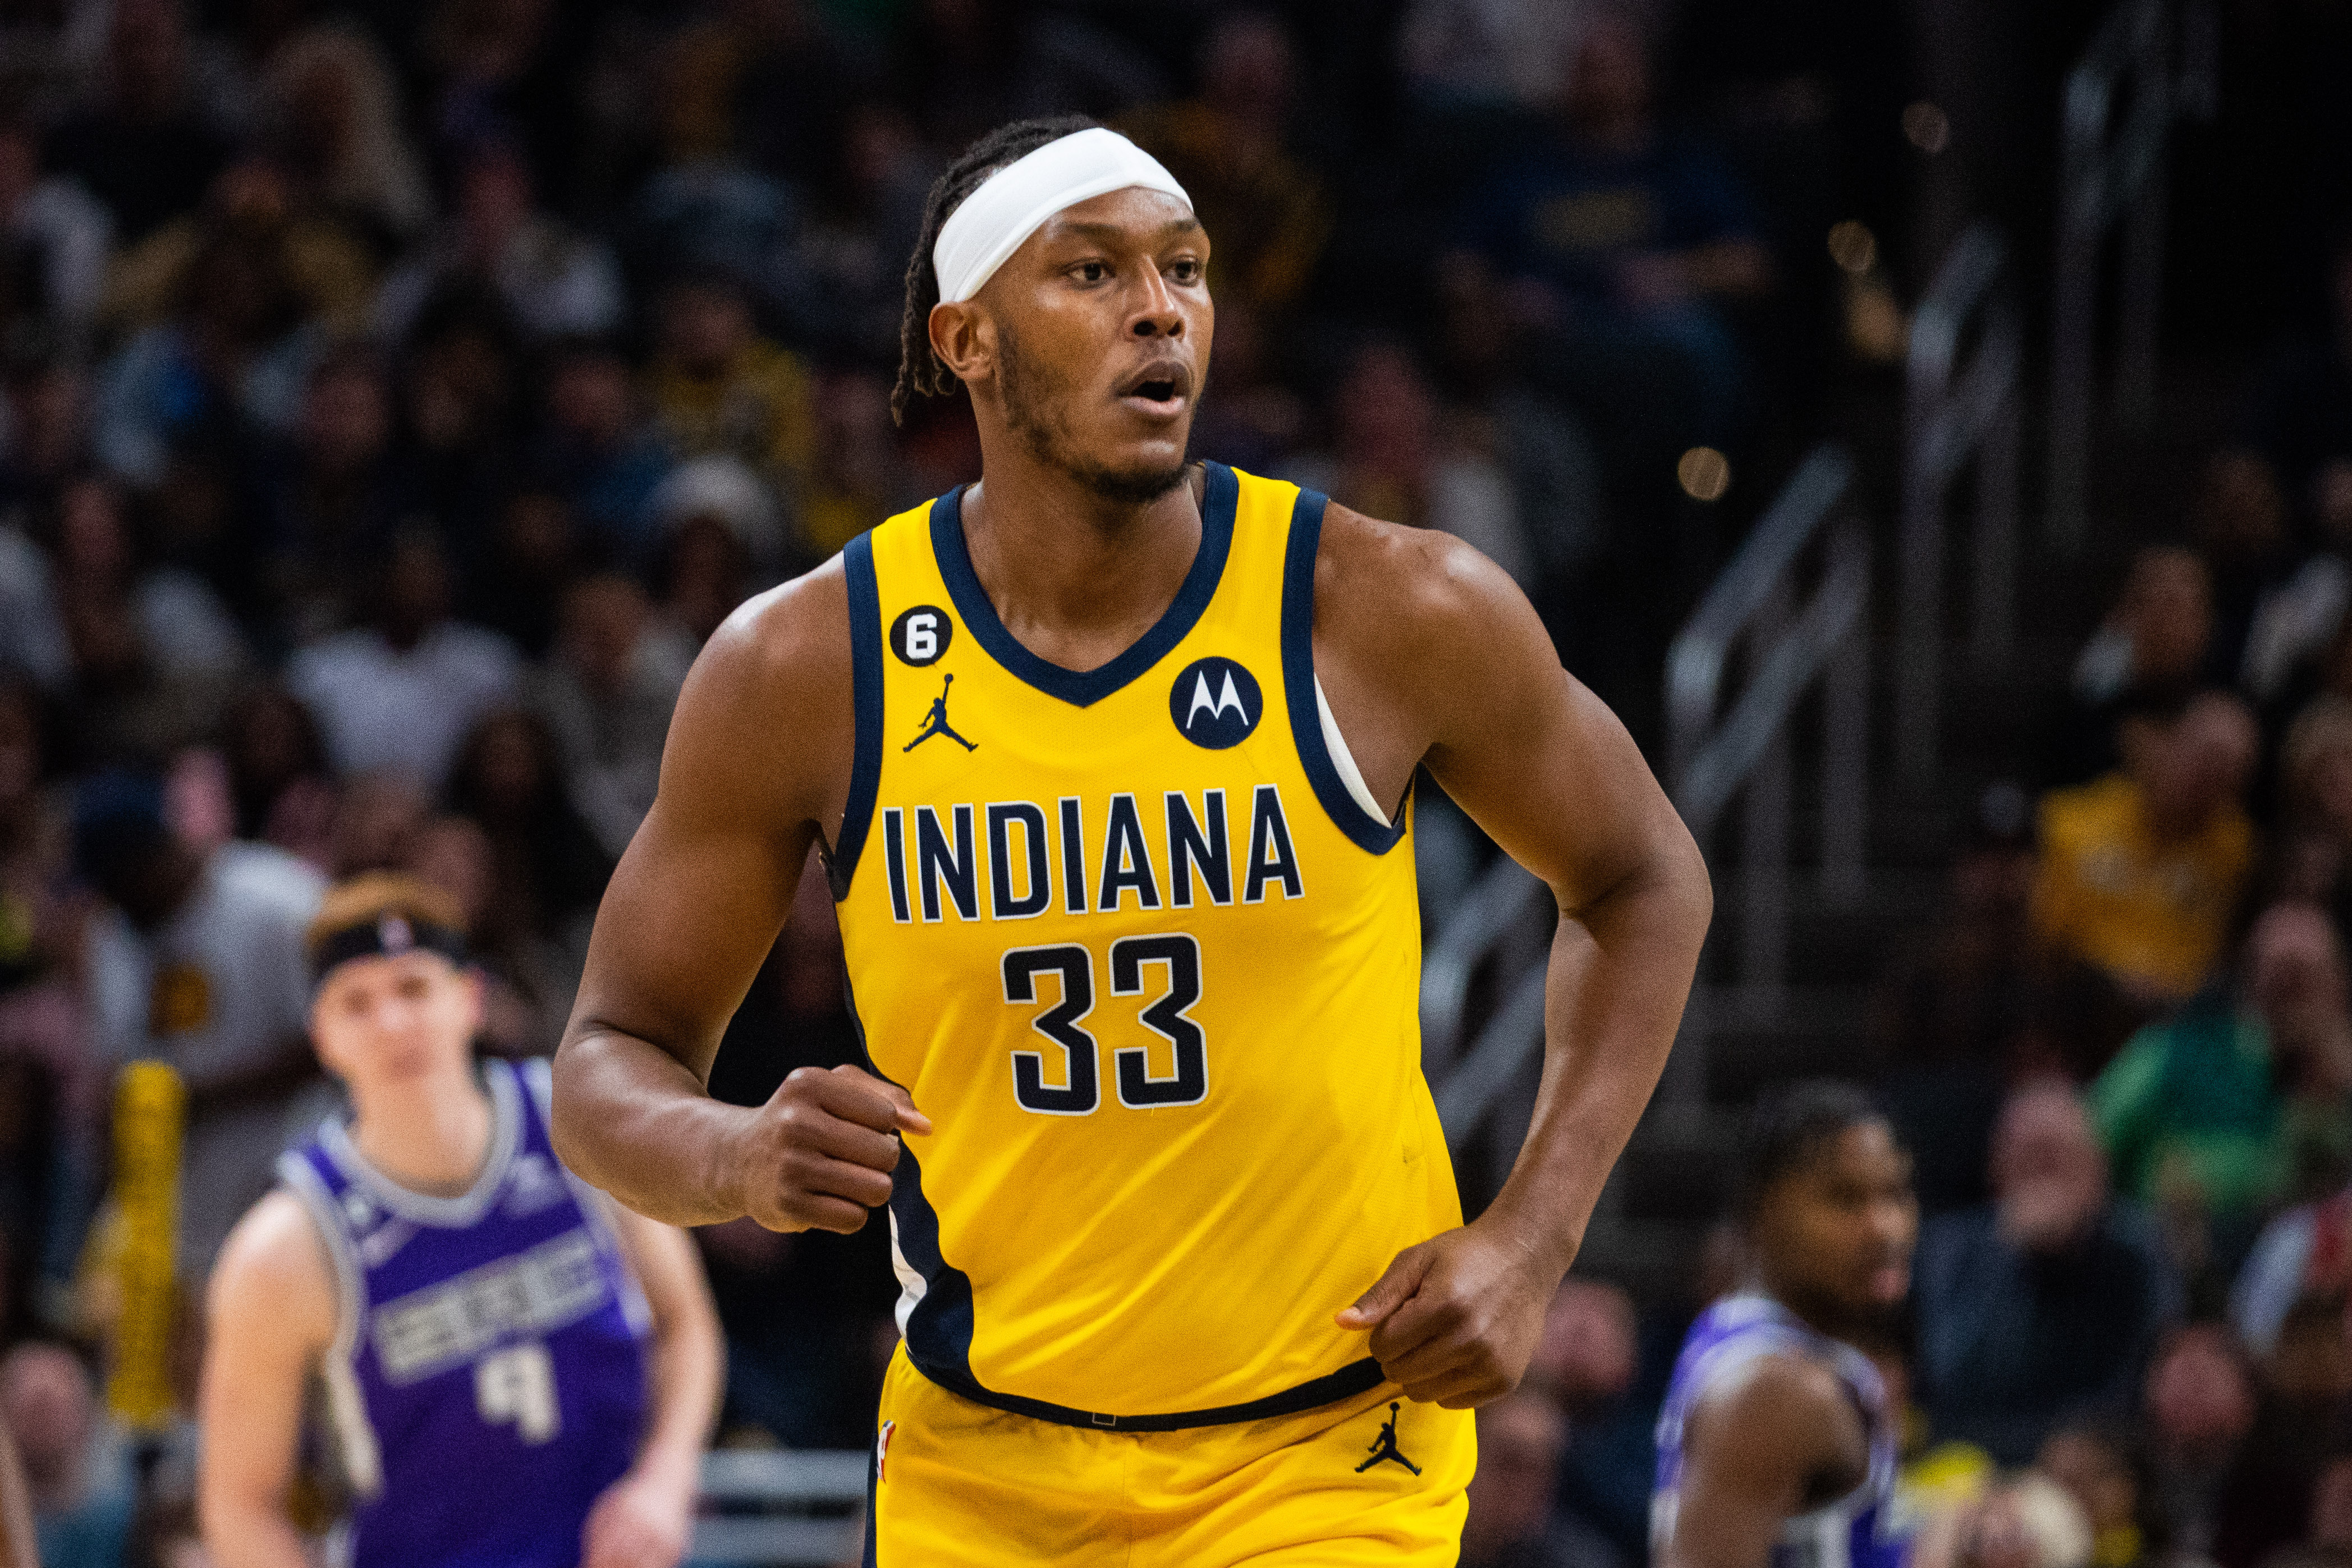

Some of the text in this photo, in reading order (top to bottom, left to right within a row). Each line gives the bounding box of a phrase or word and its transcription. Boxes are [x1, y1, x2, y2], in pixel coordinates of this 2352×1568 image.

[906, 613, 937, 659] 6
[882, 783, 1305, 924] INDIANA
[1000, 932, 1209, 1116] 33
